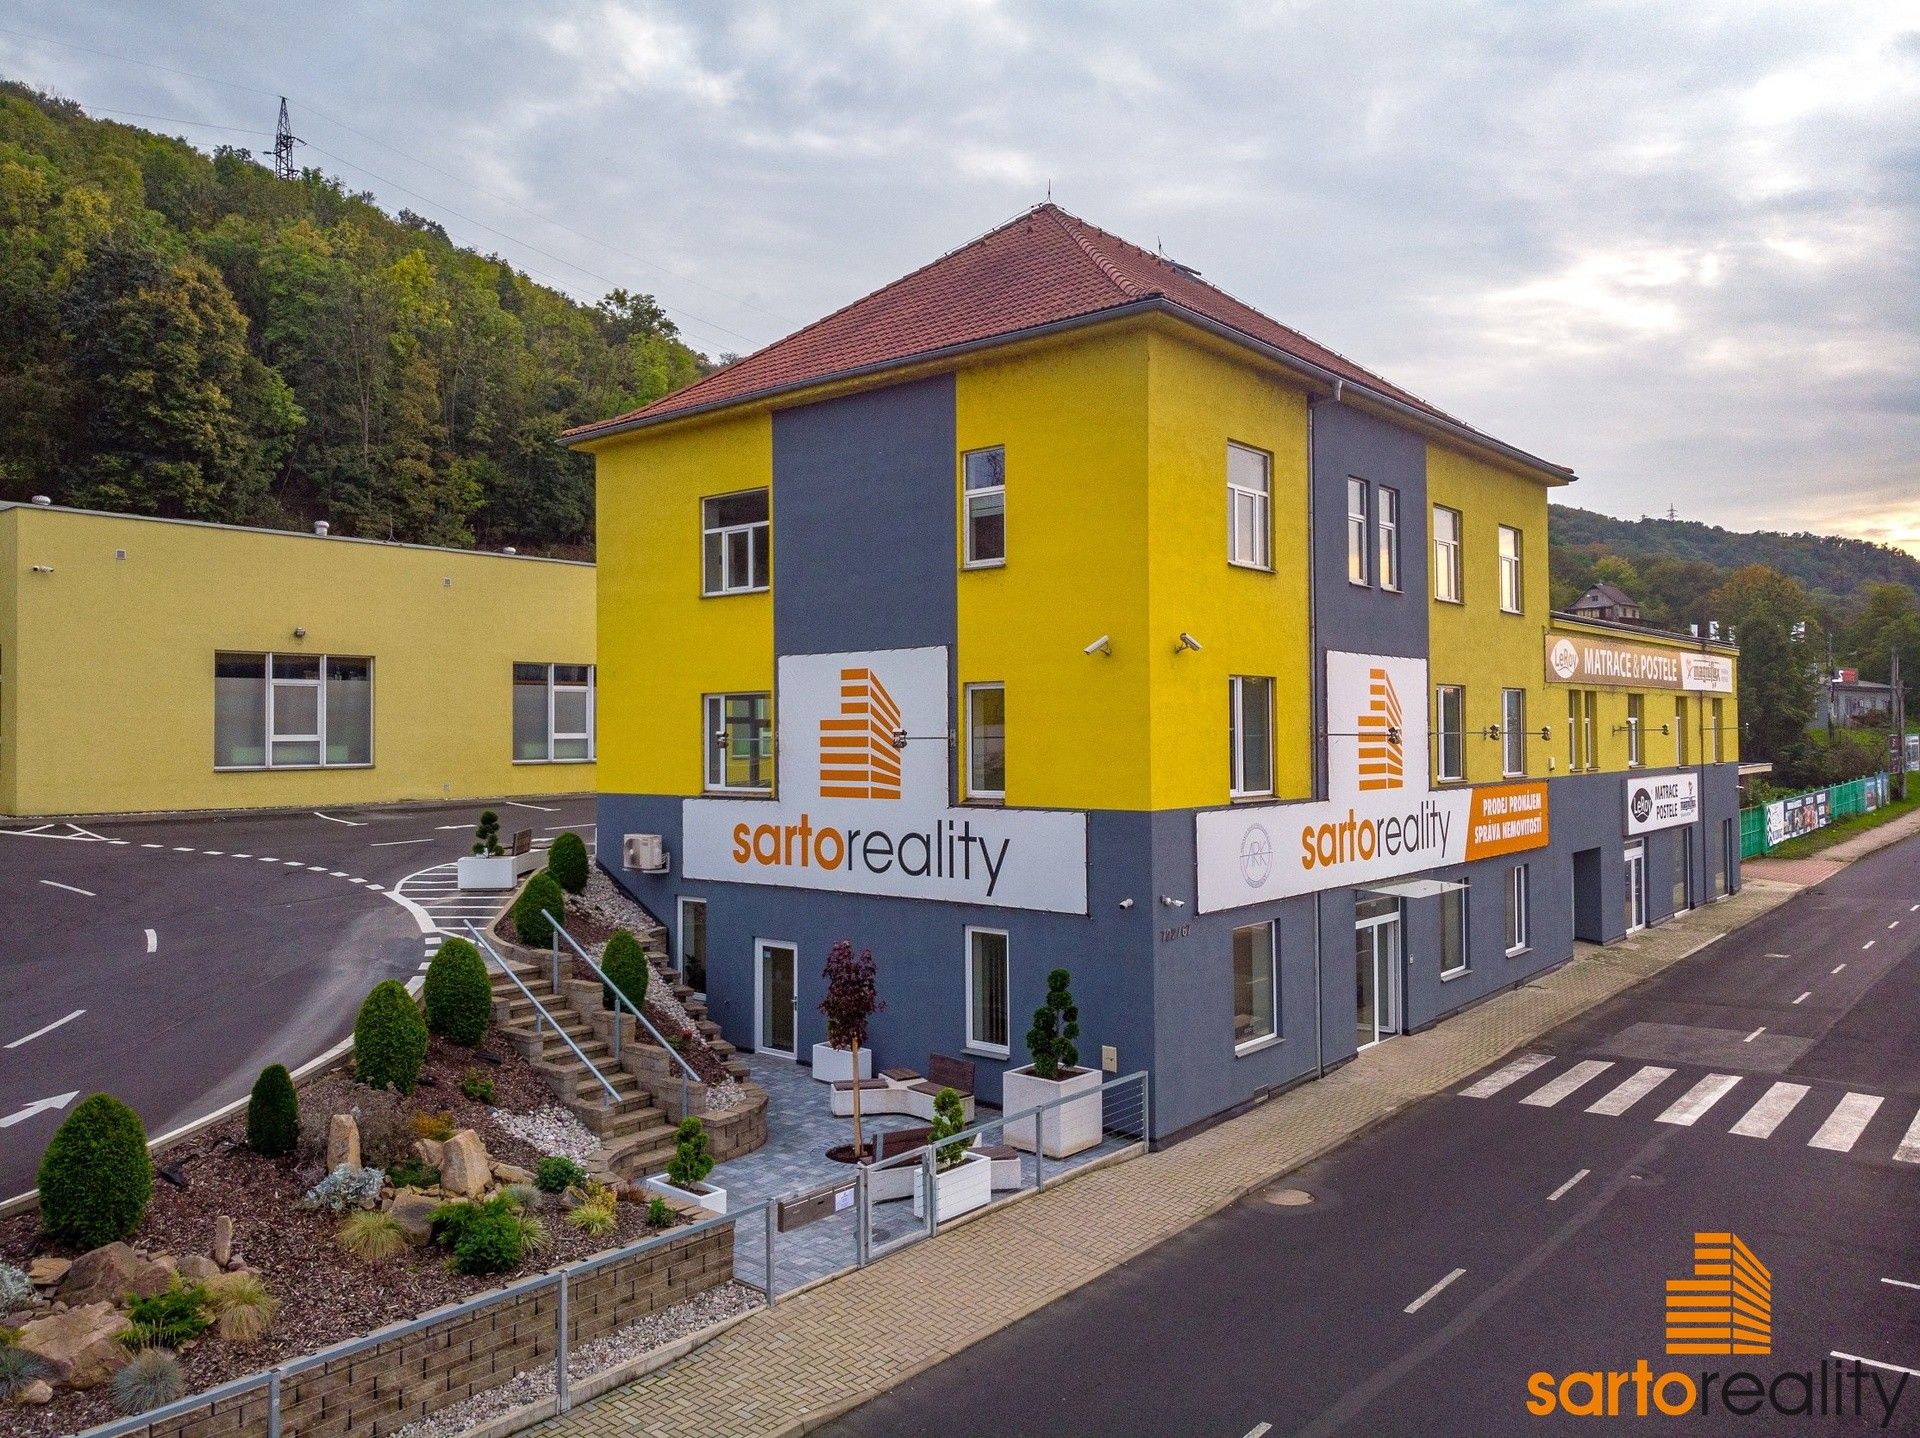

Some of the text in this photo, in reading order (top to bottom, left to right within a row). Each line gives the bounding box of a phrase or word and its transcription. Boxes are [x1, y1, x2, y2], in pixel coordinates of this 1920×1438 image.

[1584, 647, 1632, 677] MATRACE
[1641, 655, 1678, 681] POSTELE
[1483, 790, 1542, 817] PRODEJ PRONÁJEM
[1655, 783, 1678, 801] MATRACE
[1656, 803, 1678, 820] POSTELE
[1301, 800, 1451, 871] sartoreality
[1474, 812, 1542, 844] SPRÁVA NEMOVITOSTÍ
[732, 813, 1011, 897] sartoreality
